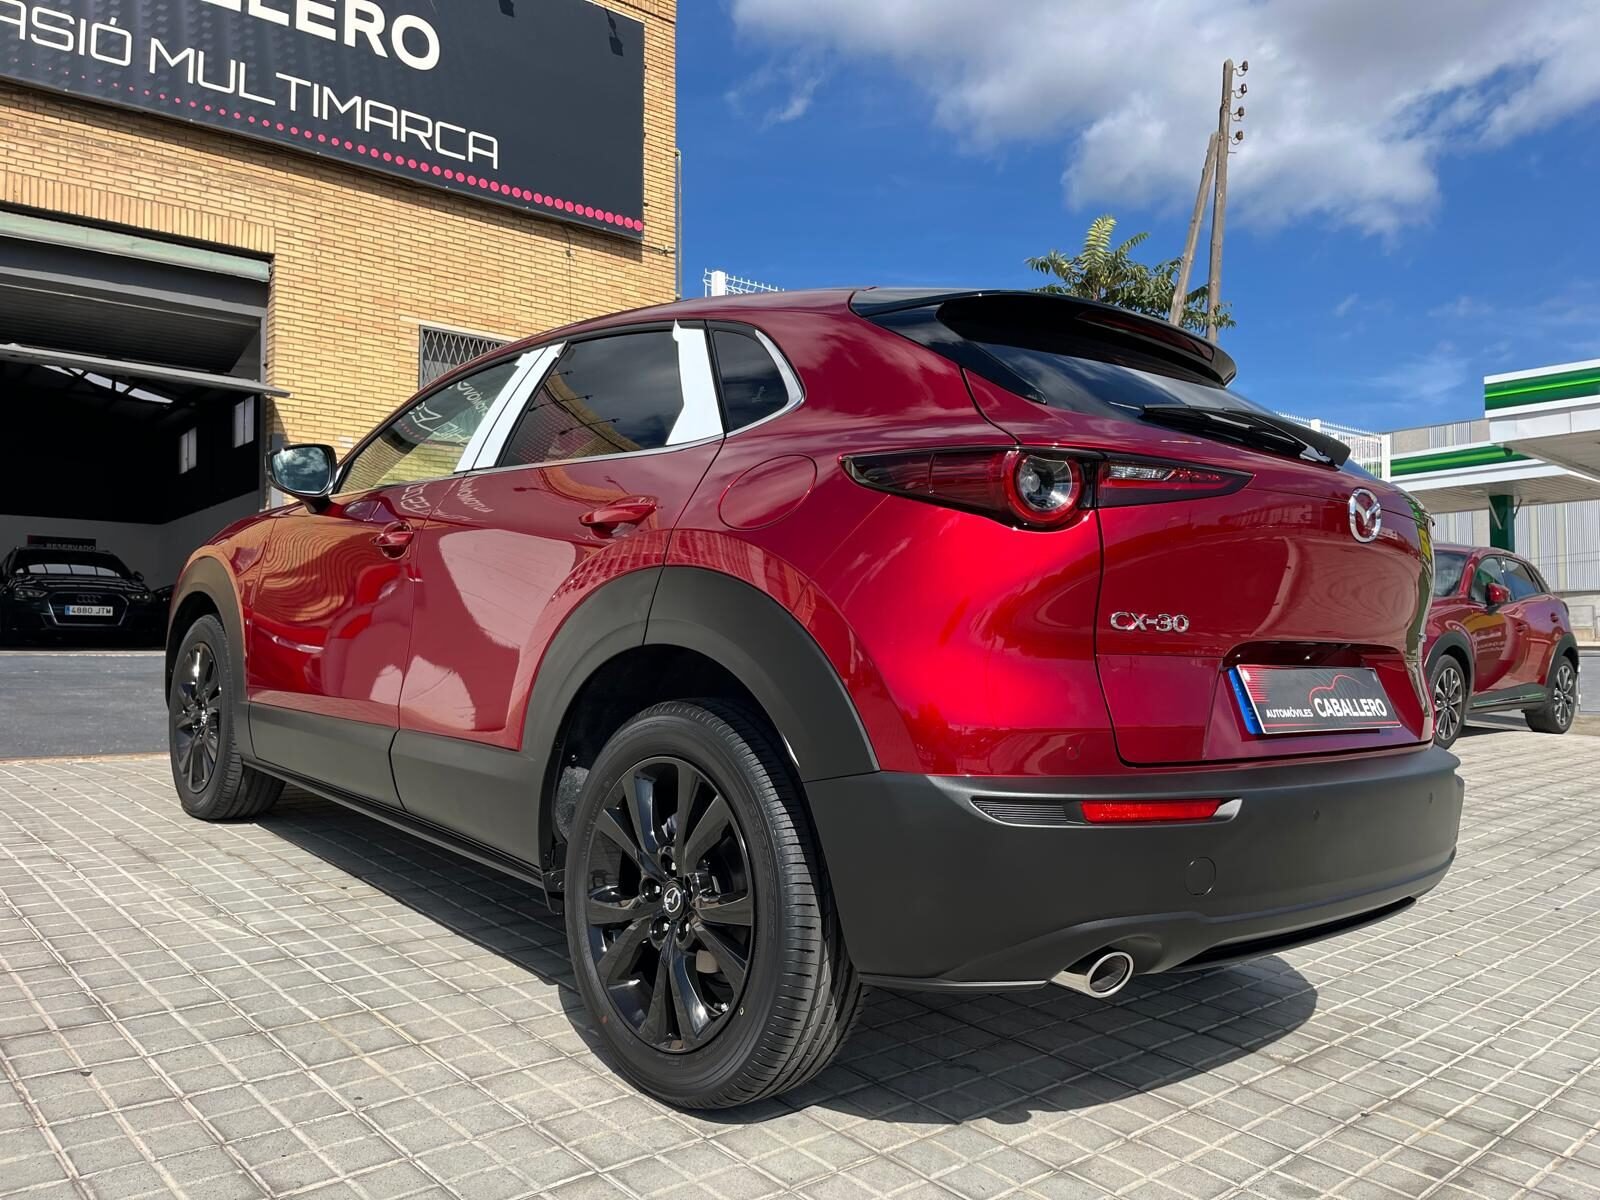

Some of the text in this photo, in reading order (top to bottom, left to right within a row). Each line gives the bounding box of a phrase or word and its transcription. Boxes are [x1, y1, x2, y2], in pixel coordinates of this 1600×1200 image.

[202, 0, 440, 71] LERO
[149, 38, 498, 169] MULTIMARCA
[1110, 611, 1190, 633] CX-30
[1266, 706, 1314, 719] AUTOMÓVILES
[1313, 697, 1388, 718] CABALLERO
